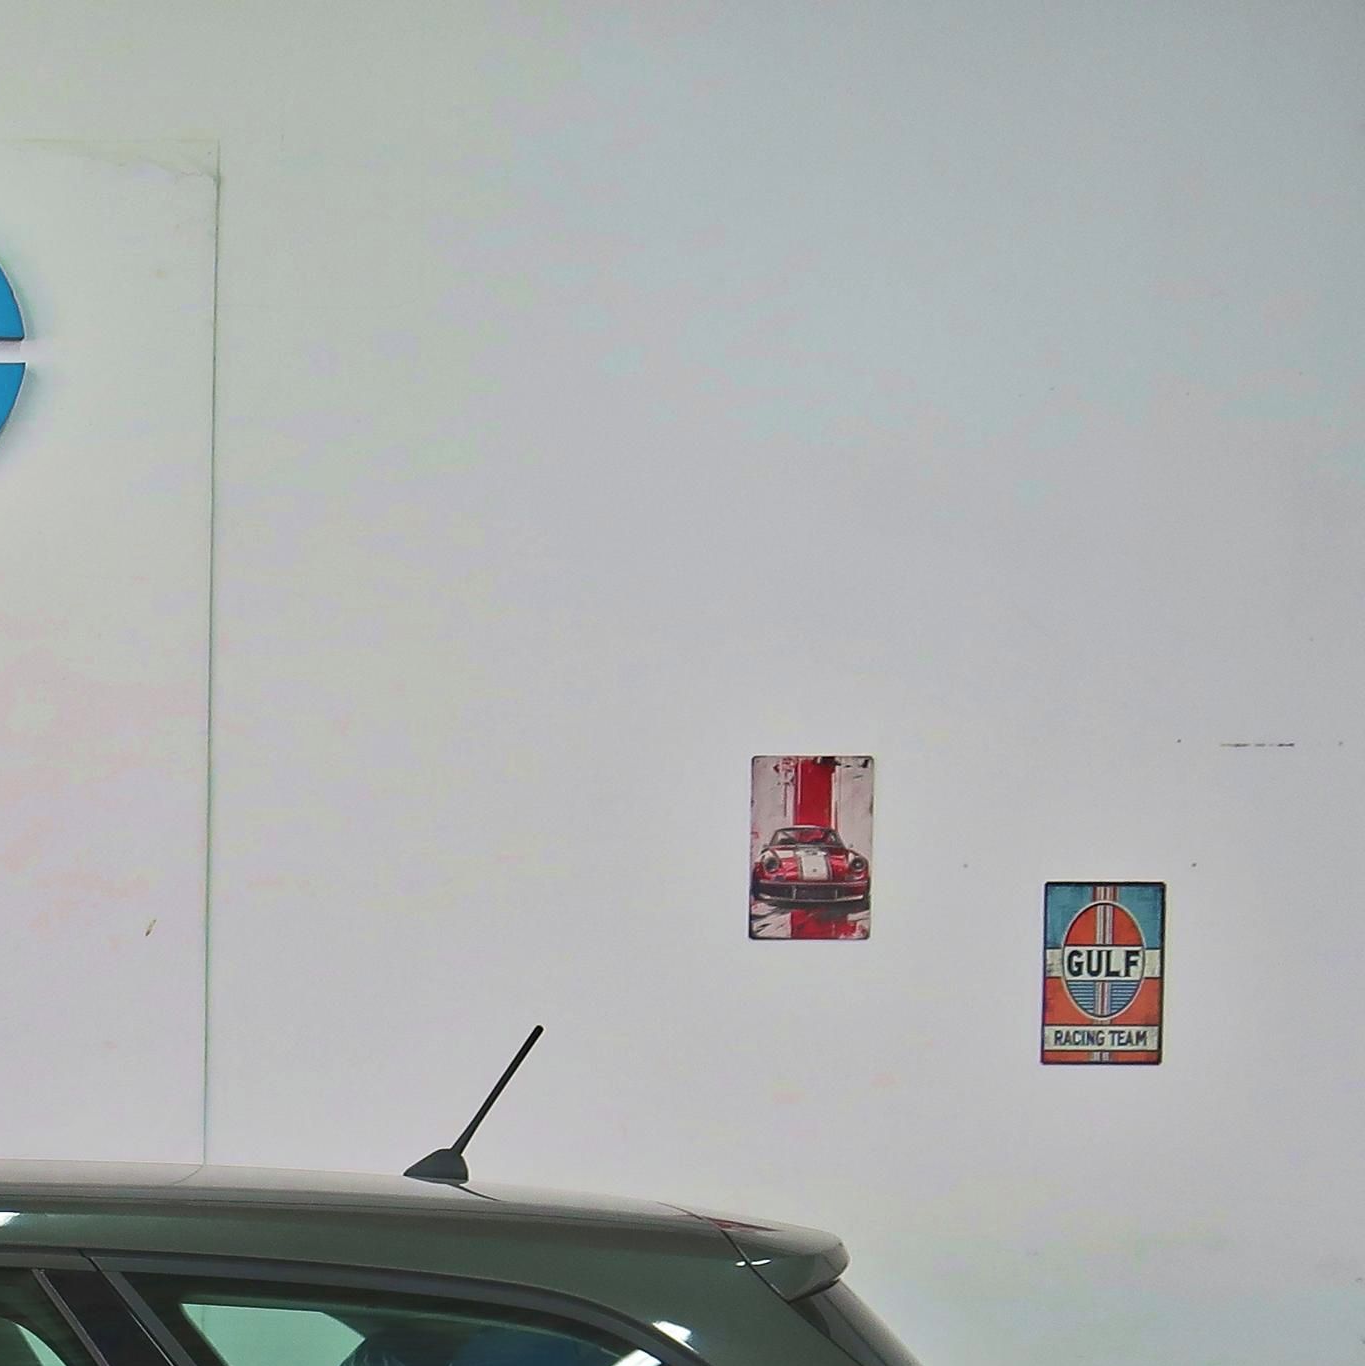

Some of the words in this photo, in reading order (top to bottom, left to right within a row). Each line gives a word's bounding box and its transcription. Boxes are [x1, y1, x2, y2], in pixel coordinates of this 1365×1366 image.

[1067, 950, 1141, 978] GULF
[1053, 1030, 1105, 1046] RACING
[1108, 1030, 1148, 1047] TEAM
